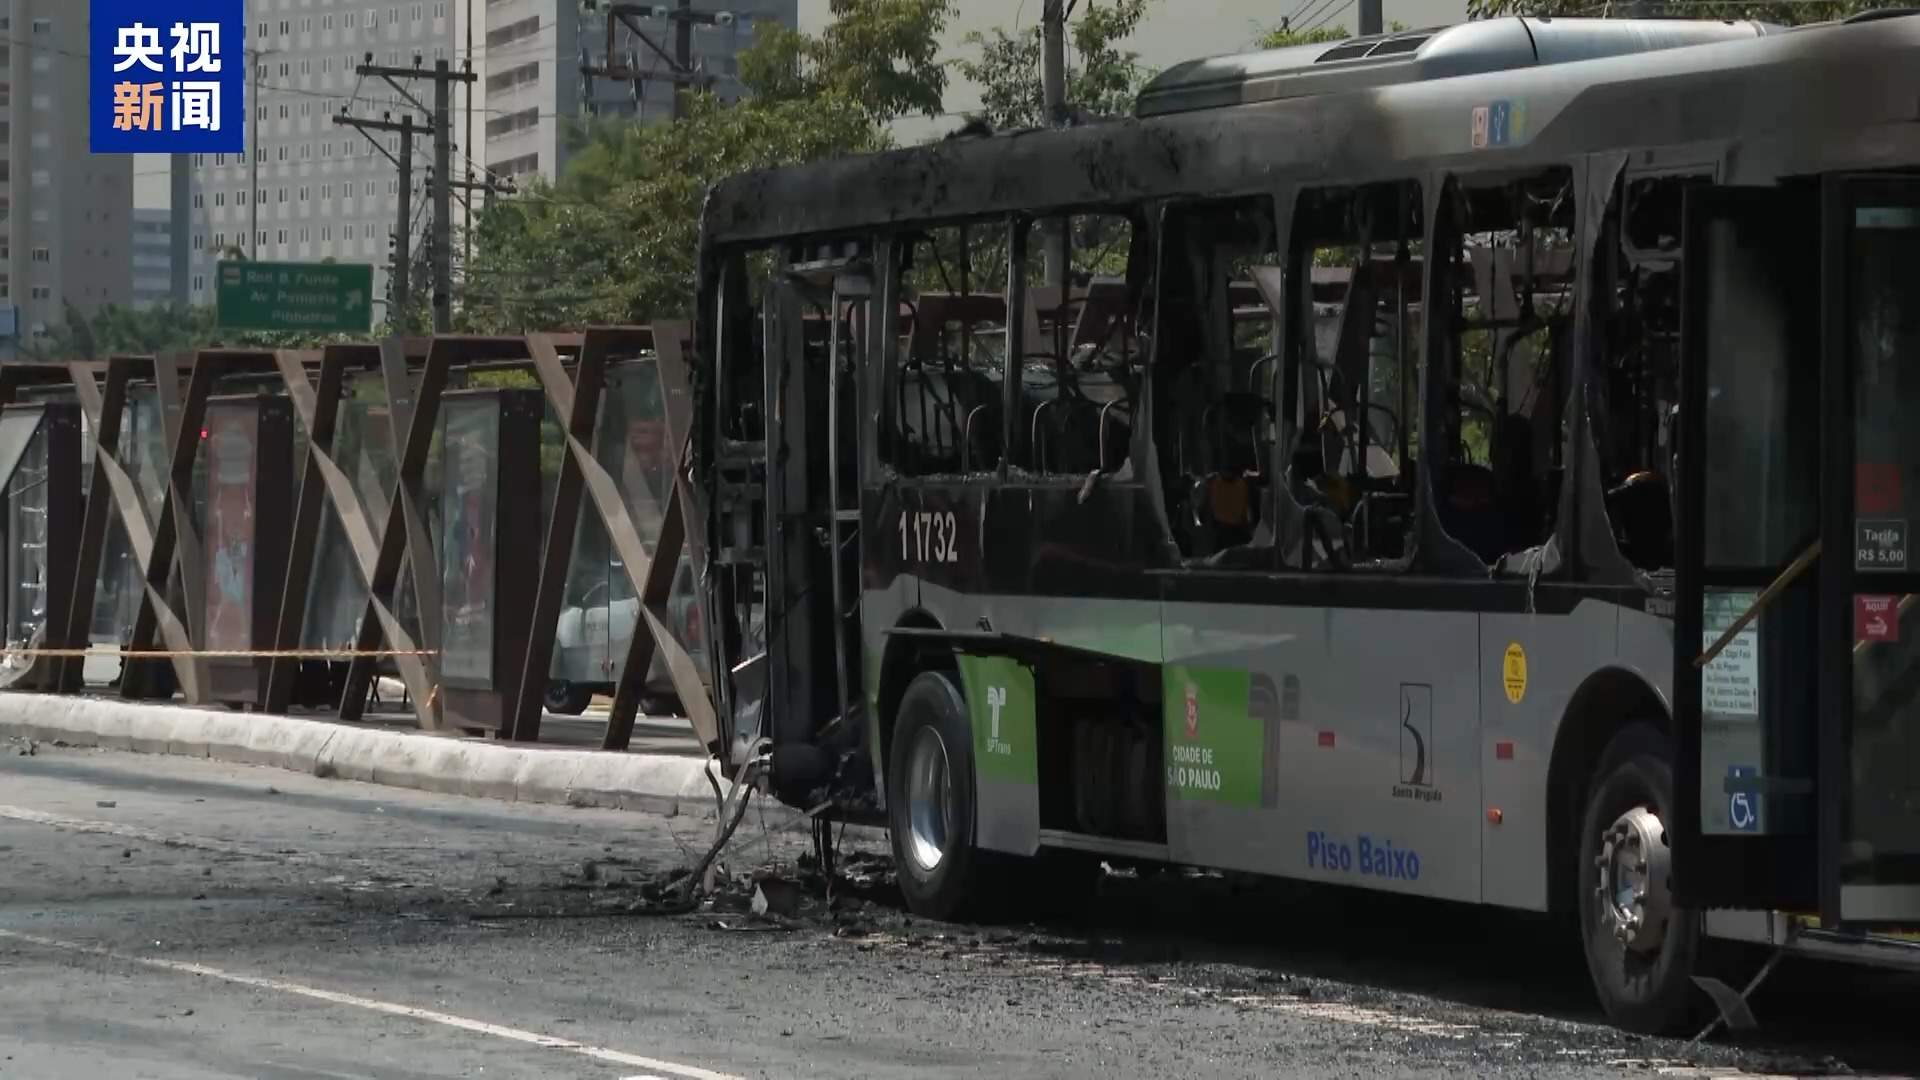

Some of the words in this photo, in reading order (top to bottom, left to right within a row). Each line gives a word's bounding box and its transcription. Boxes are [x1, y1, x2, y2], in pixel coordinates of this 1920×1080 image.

[1864, 528, 1900, 542] Tarifa
[1858, 549, 1875, 561] R$
[1878, 549, 1904, 563] 5,00
[1172, 745, 1201, 763] CIDADE
[1202, 748, 1214, 765] DE
[1188, 768, 1221, 790] PAULO
[1306, 831, 1351, 872] Piso
[1358, 835, 1421, 881] Baixo
